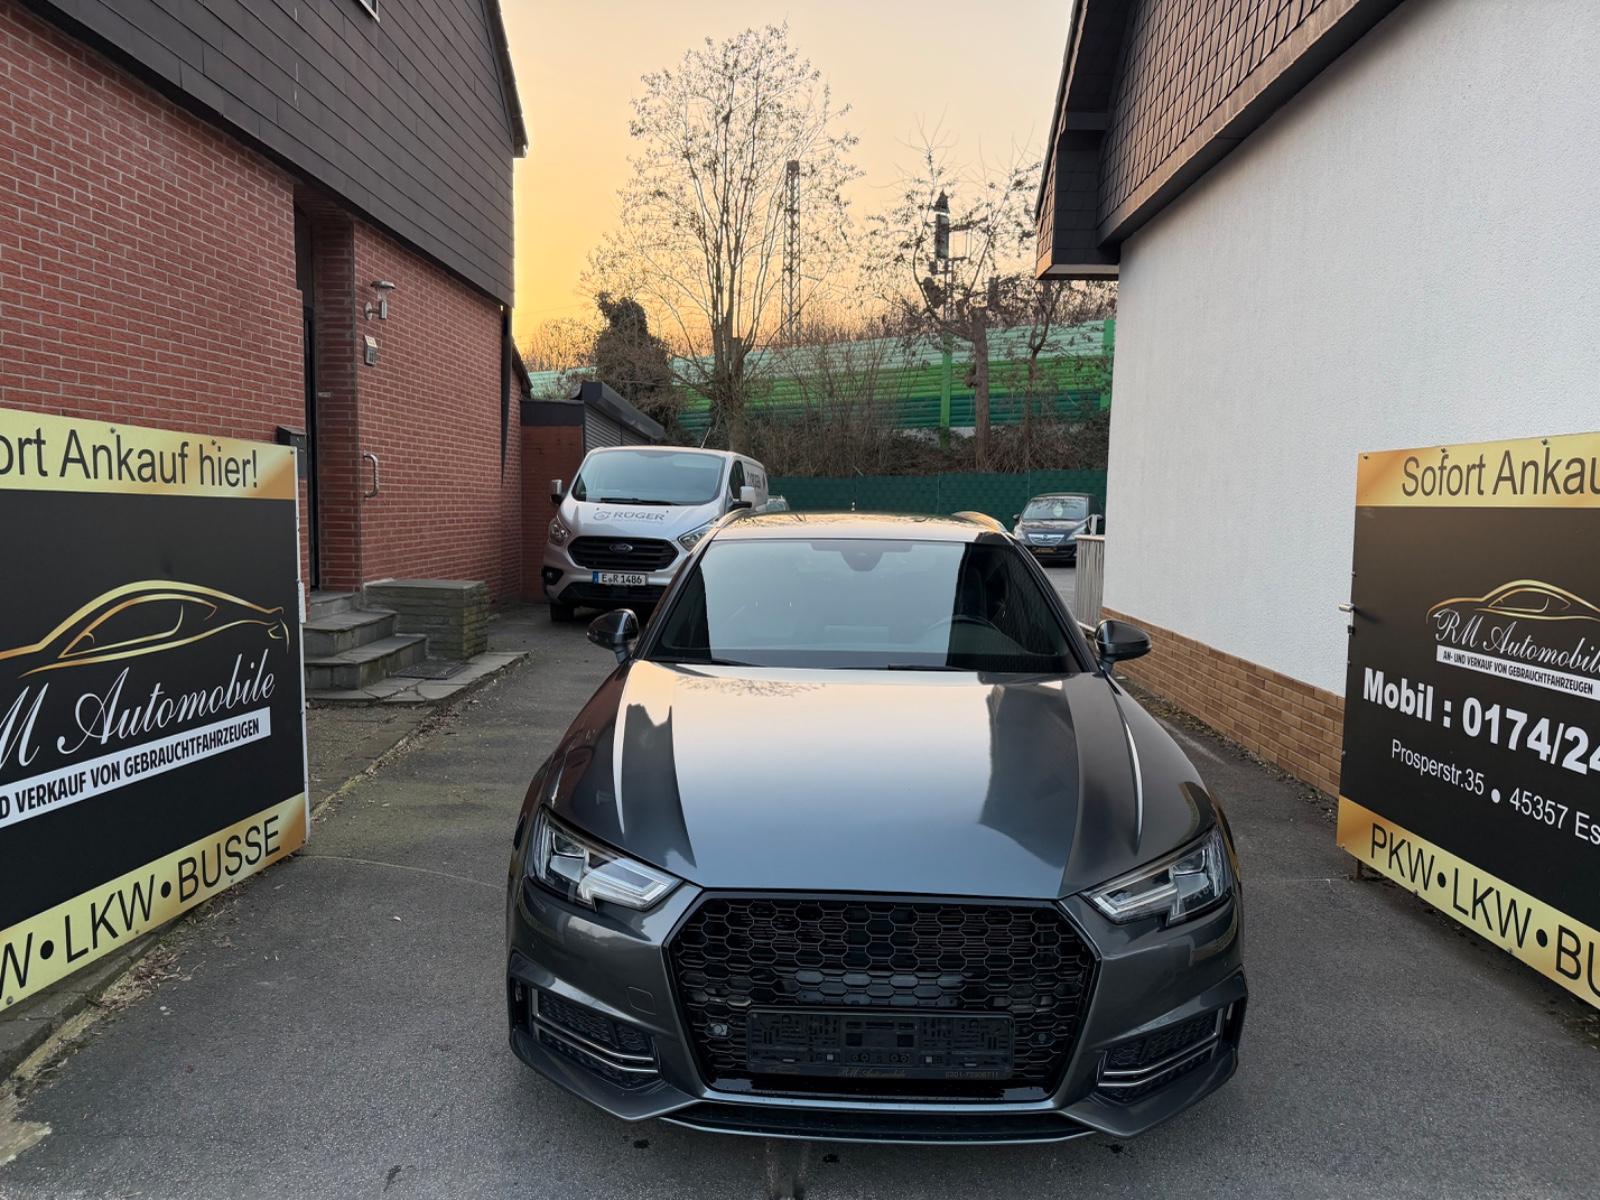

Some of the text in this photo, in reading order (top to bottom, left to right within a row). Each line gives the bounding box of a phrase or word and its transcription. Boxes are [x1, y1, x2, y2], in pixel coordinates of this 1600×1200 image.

[59, 429, 189, 484] Ankauf
[199, 443, 258, 488] hier!
[1402, 453, 1486, 497] Sofort
[1433, 608, 1600, 674] RM Automobil
[57, 648, 276, 755] Automobile
[1363, 667, 1434, 722] Mobil
[1454, 653, 1467, 665] UND
[1467, 656, 1493, 671] VERKAUF
[1494, 662, 1508, 675] VON
[1508, 665, 1594, 695] GEBRAUCHTFAHRZEUGEN
[15, 771, 87, 813] VERKAUF
[90, 760, 121, 788] VON
[124, 717, 260, 778] GEBRAUCHTFAHRZEUGEN
[1391, 738, 1485, 796] Prosperstr.35
[1509, 787, 1569, 829] 45357
